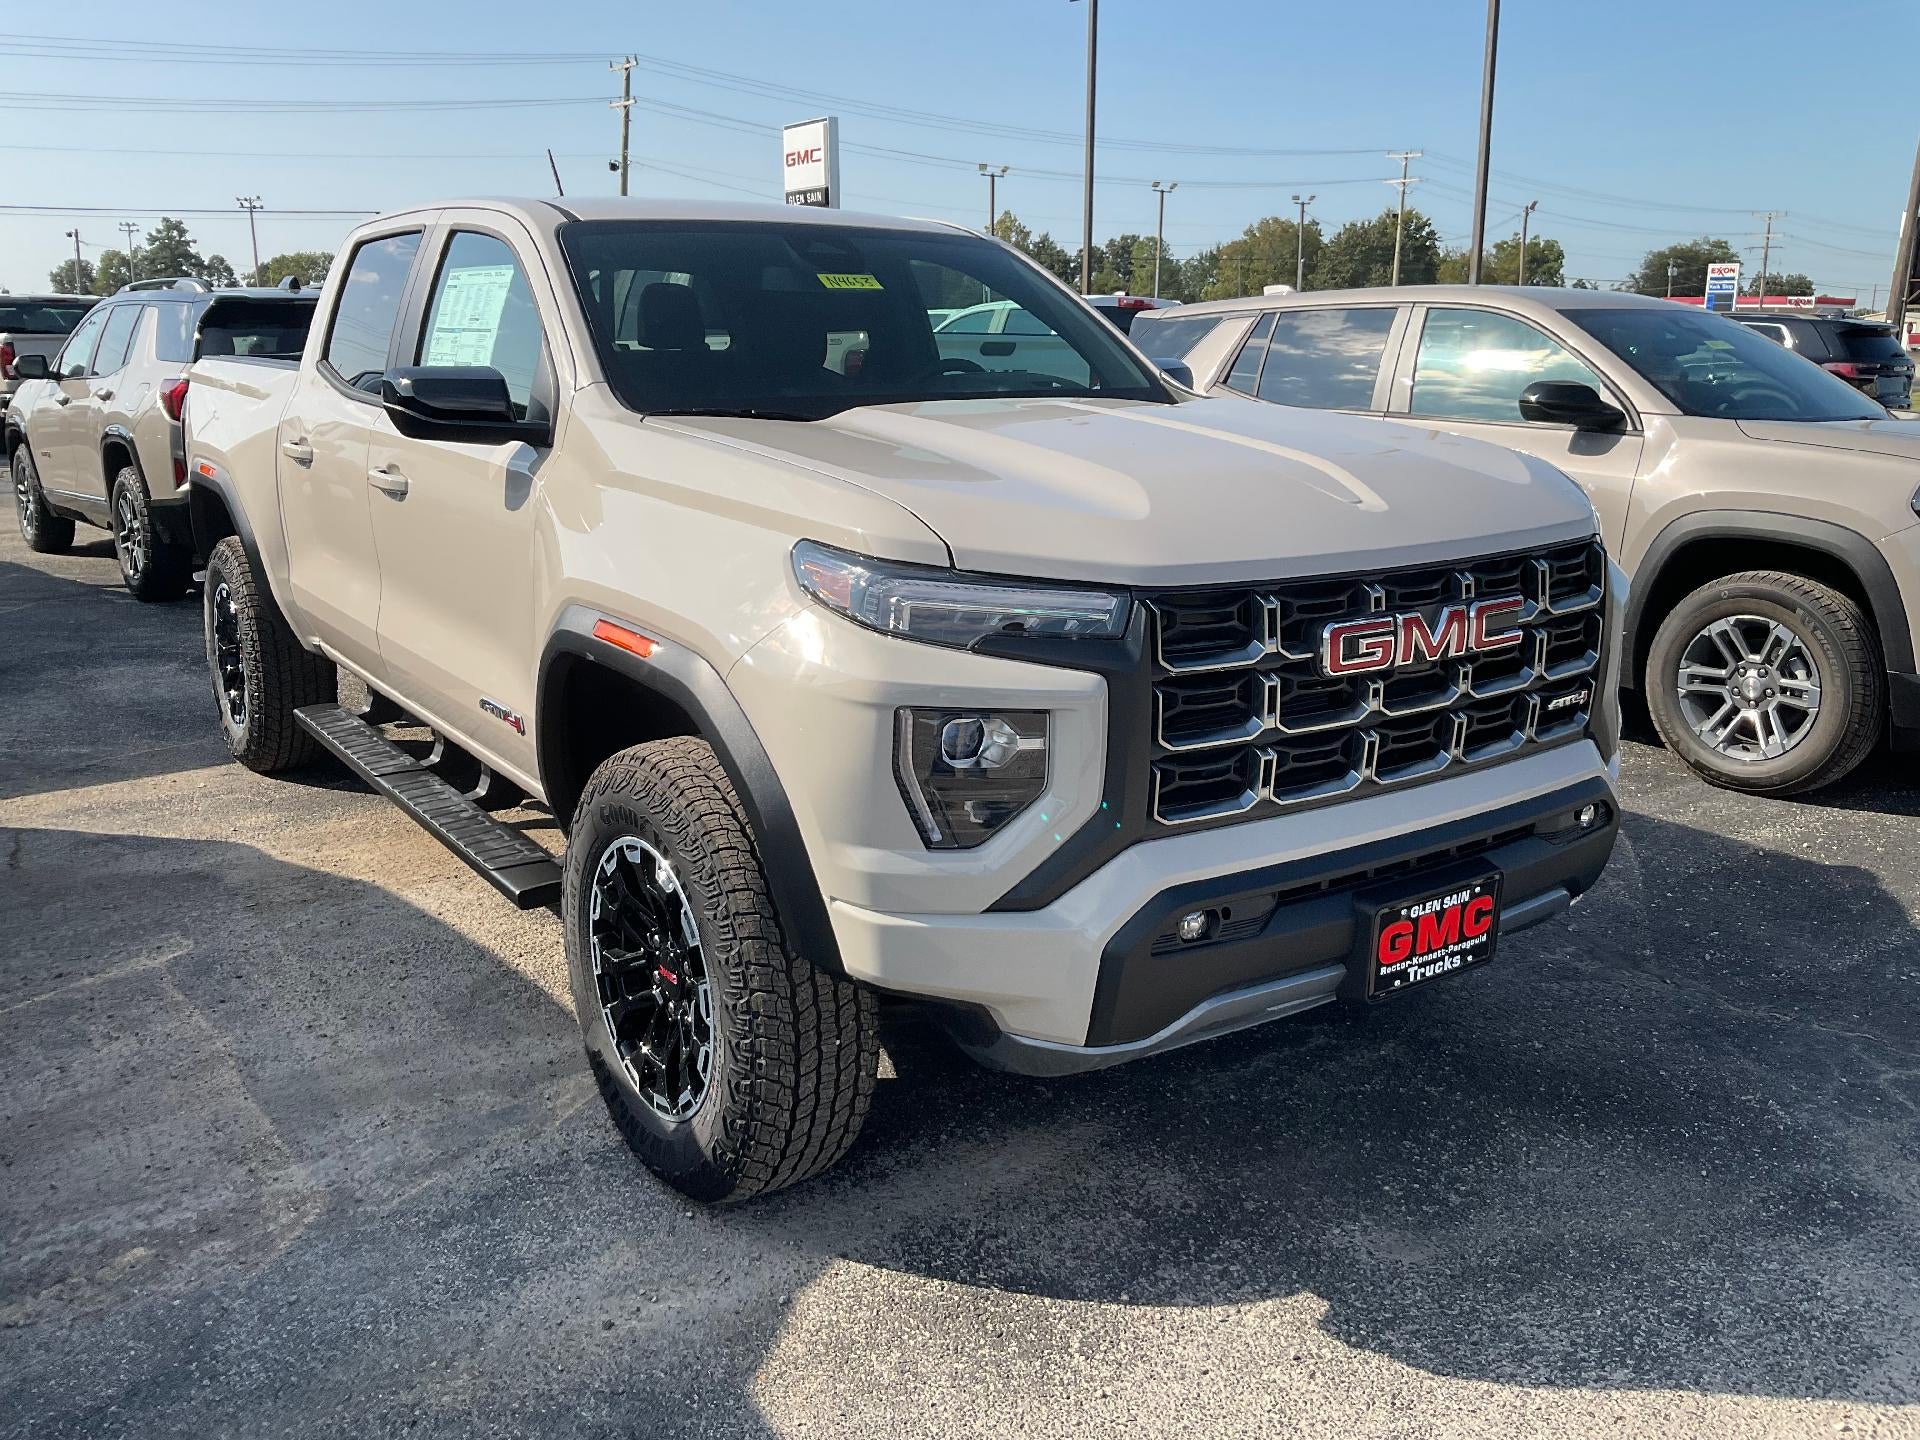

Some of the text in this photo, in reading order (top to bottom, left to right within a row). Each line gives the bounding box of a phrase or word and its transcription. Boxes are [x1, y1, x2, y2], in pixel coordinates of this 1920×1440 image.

[785, 148, 822, 167] GMC
[788, 191, 822, 205] GLEN SAIN
[1711, 267, 1736, 276] EXXON
[1321, 596, 1524, 676] GMC
[1410, 889, 1471, 918] GLEN SAIN
[1378, 895, 1493, 965] GMC
[1408, 954, 1461, 982] Trucks
